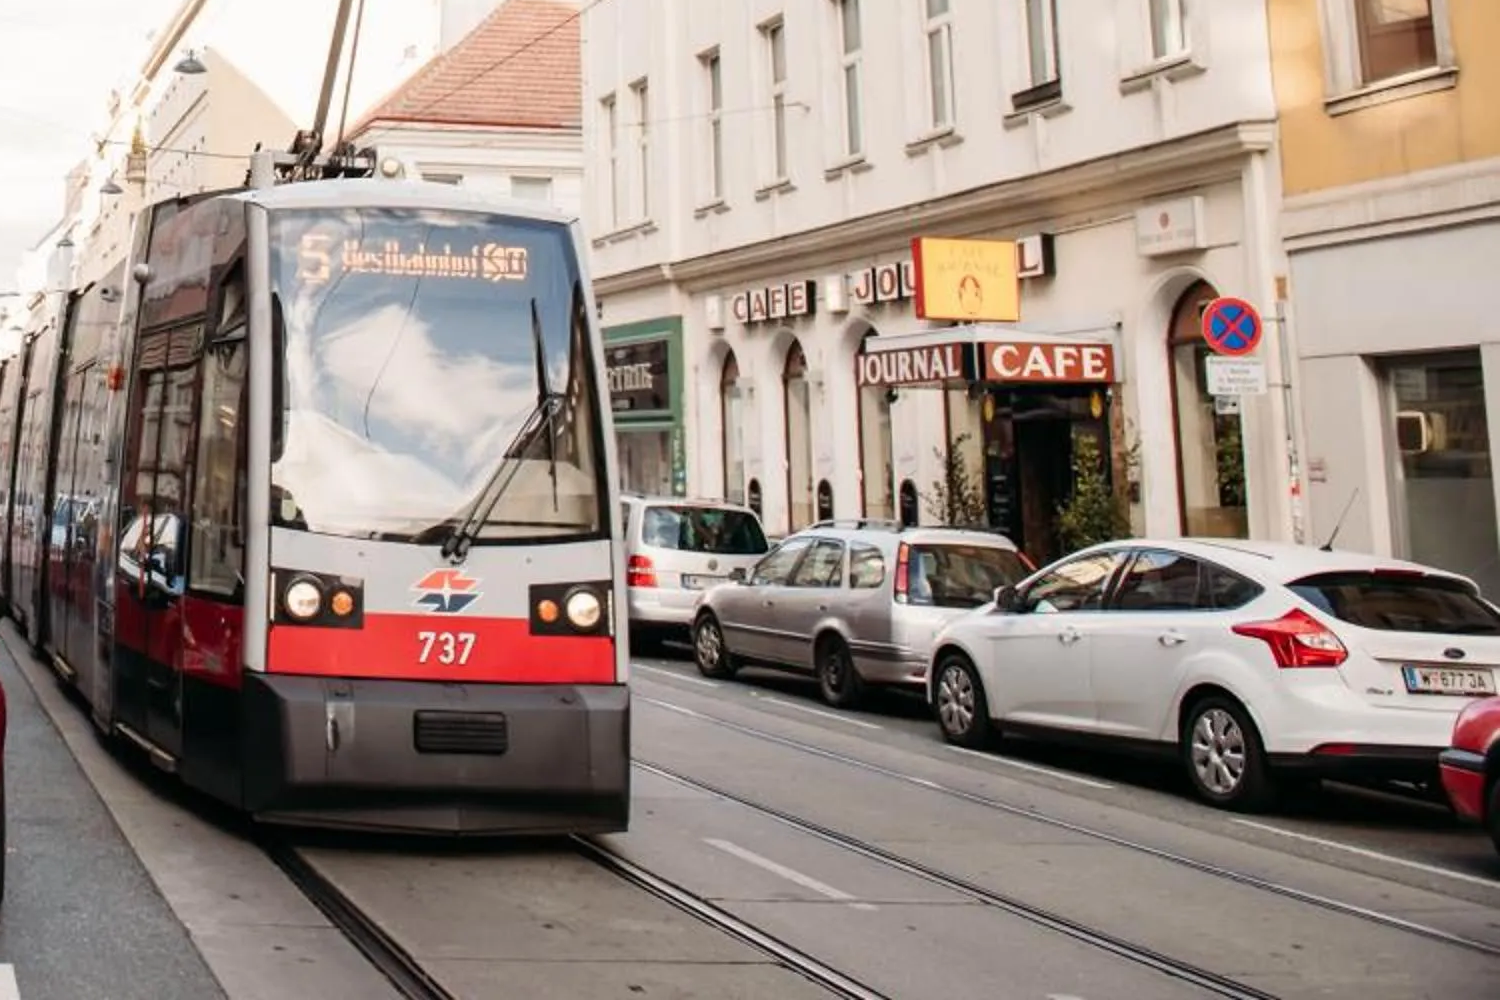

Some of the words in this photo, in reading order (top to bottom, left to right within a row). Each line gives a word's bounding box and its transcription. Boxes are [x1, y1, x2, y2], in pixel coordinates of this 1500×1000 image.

[297, 232, 331, 285] 5
[733, 281, 805, 321] CAFE
[855, 242, 1039, 300] JOUL
[858, 343, 961, 385] JOURNAL
[991, 344, 1108, 379] CAFE
[417, 631, 476, 665] 737
